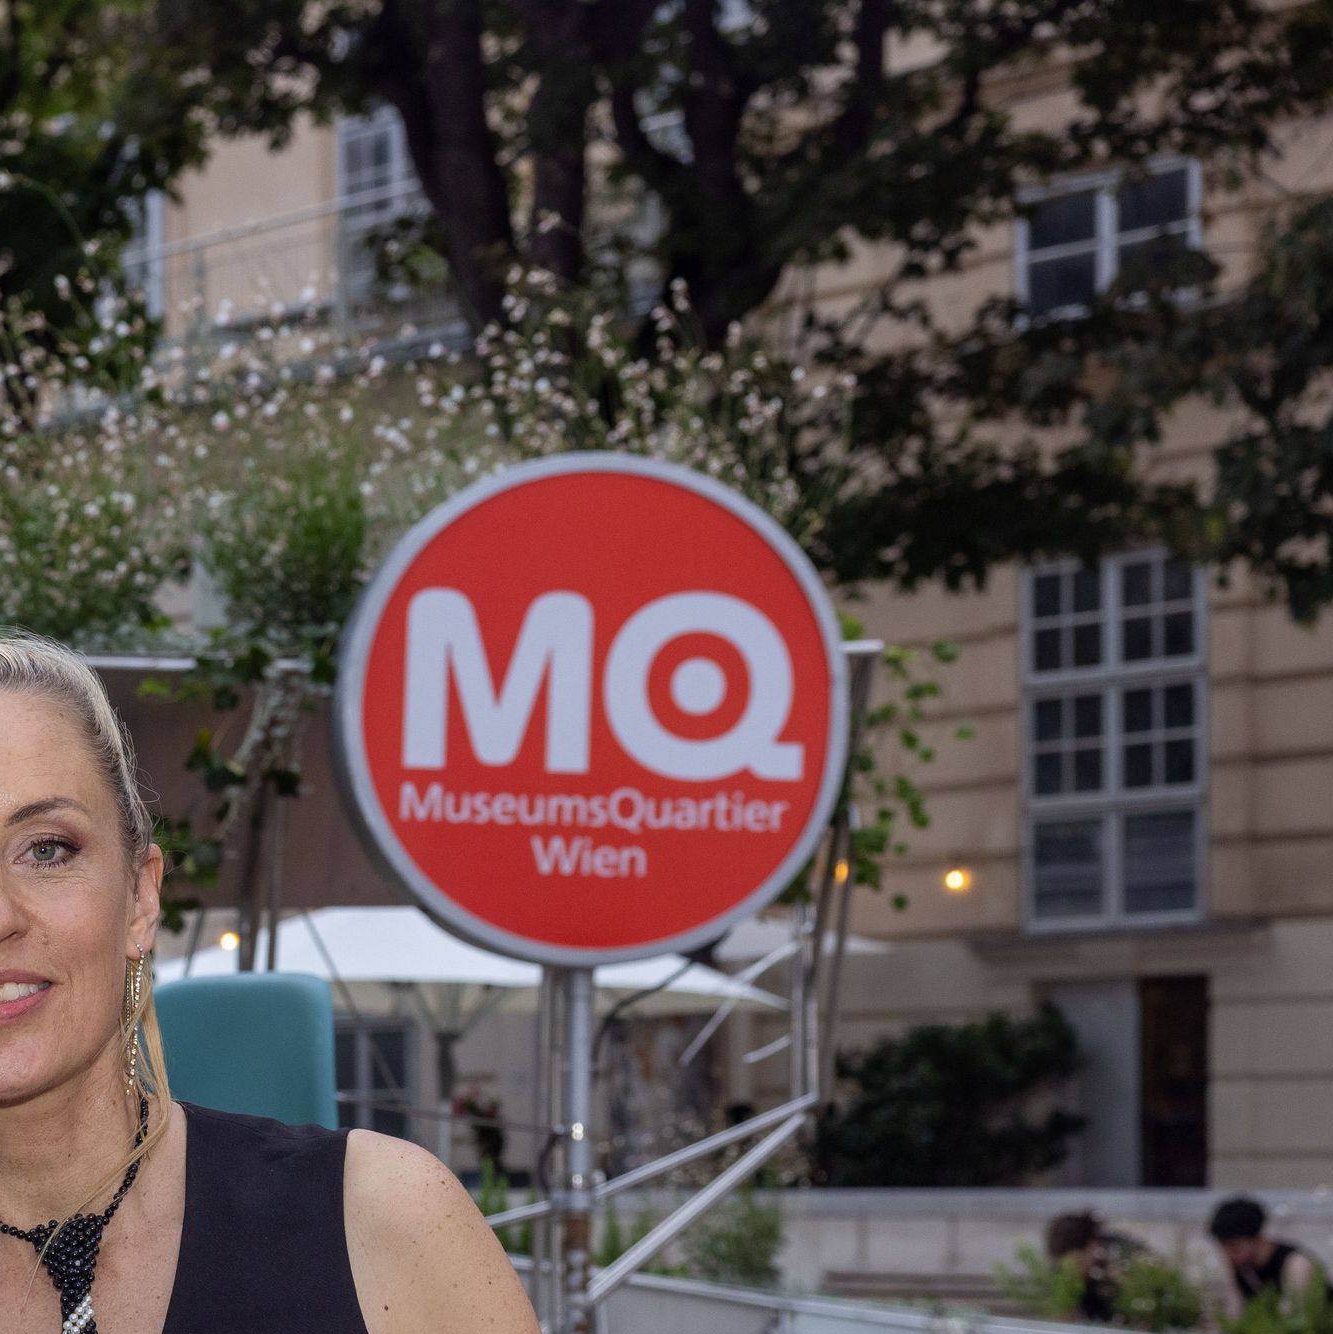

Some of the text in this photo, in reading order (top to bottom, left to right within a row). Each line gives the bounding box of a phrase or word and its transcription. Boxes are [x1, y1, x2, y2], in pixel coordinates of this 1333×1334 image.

[403, 587, 804, 782] MQ
[399, 782, 787, 834] MuseumsQuartier
[532, 836, 646, 877] Wien
